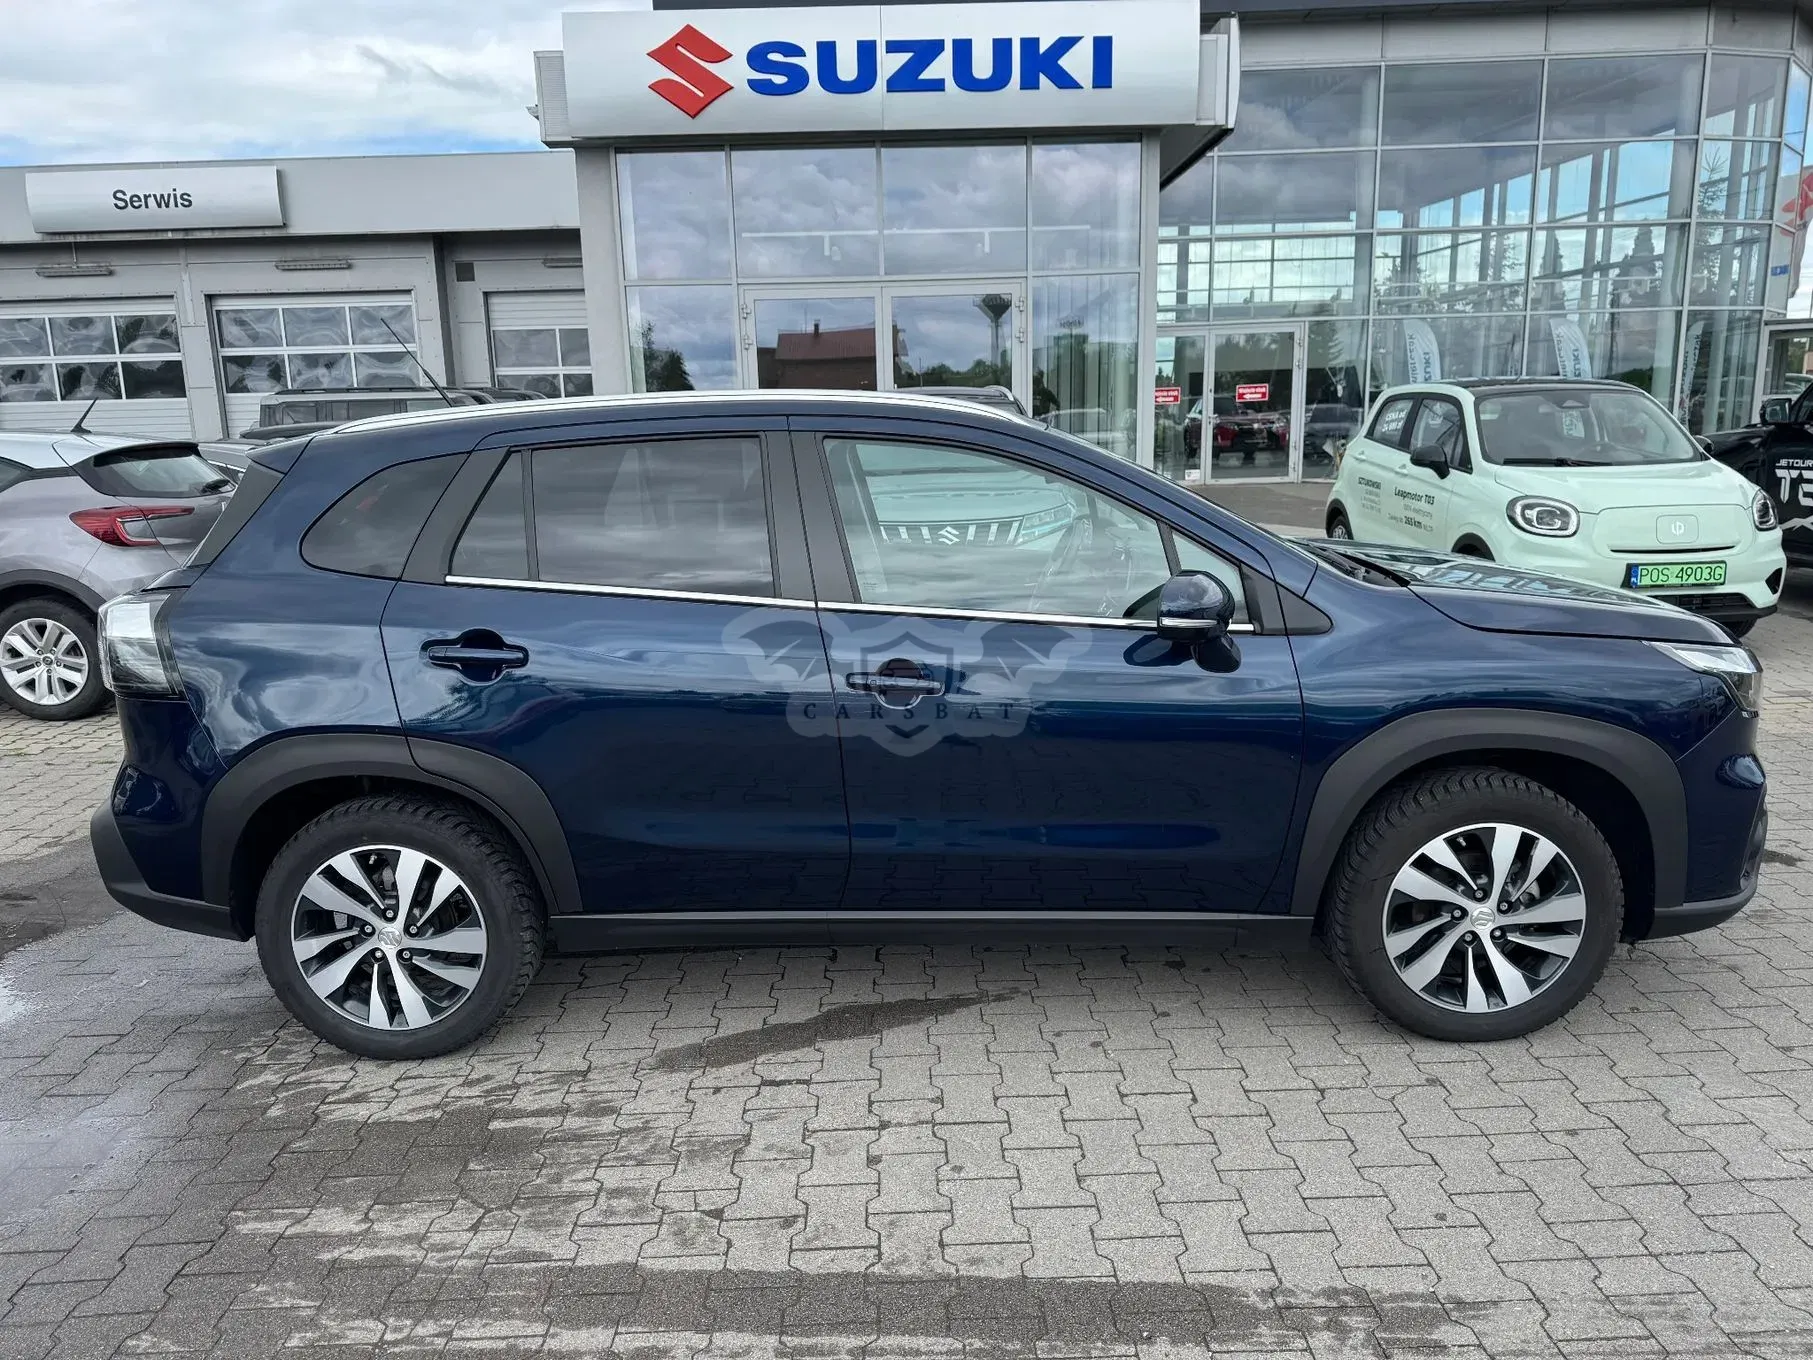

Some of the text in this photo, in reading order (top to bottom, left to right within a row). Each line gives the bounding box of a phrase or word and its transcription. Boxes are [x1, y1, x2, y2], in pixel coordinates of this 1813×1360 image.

[745, 35, 1113, 97] SUZUKI
[112, 187, 193, 210] Serwis
[1775, 459, 1813, 467] JETOUR
[1394, 486, 1424, 503] Leapmotor
[1424, 494, 1436, 506] T03
[1639, 566, 1723, 583] POS 4903G
